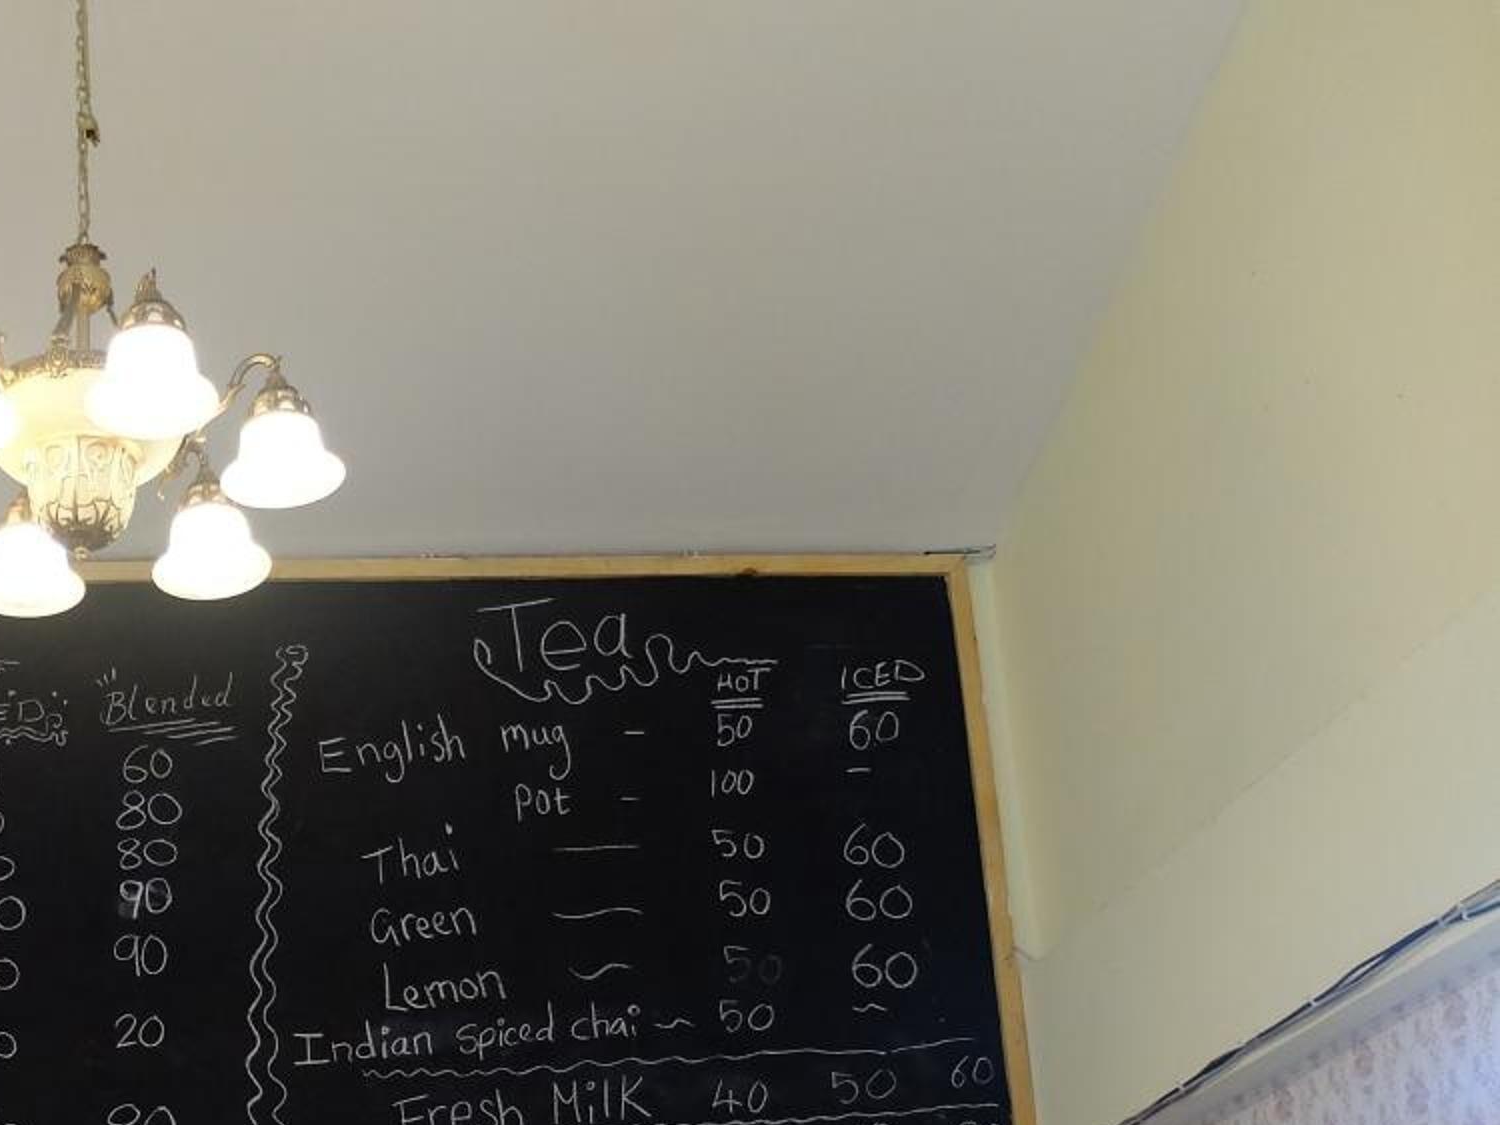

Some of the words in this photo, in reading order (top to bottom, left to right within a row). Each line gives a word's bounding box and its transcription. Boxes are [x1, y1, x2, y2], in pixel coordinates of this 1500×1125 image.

[477, 597, 631, 672] Tea
[102, 672, 233, 726] Blended
[717, 668, 771, 692] HOT
[841, 659, 926, 690] ICED
[122, 745, 173, 784] 60
[319, 714, 466, 783] English
[501, 723, 572, 780] mug
[717, 714, 753, 747] 50
[849, 709, 900, 750] 60
[711, 769, 755, 798] 100
[116, 791, 183, 830] 80
[117, 837, 179, 870] 80
[360, 822, 461, 884] Thai
[711, 829, 766, 859] 50
[843, 822, 905, 868] 60
[119, 877, 173, 920] 90
[370, 907, 477, 948] Green
[719, 879, 771, 917] 50
[845, 879, 913, 921] 60
[113, 933, 168, 978] 90
[383, 961, 507, 1012] Lemon
[851, 943, 918, 989] 60
[114, 1013, 166, 1049] 20
[293, 1018, 434, 1066] Indian
[719, 1000, 774, 1032] 50
[712, 1078, 768, 1114] 40
[831, 1068, 897, 1104] 50
[950, 1055, 994, 1088] 60
